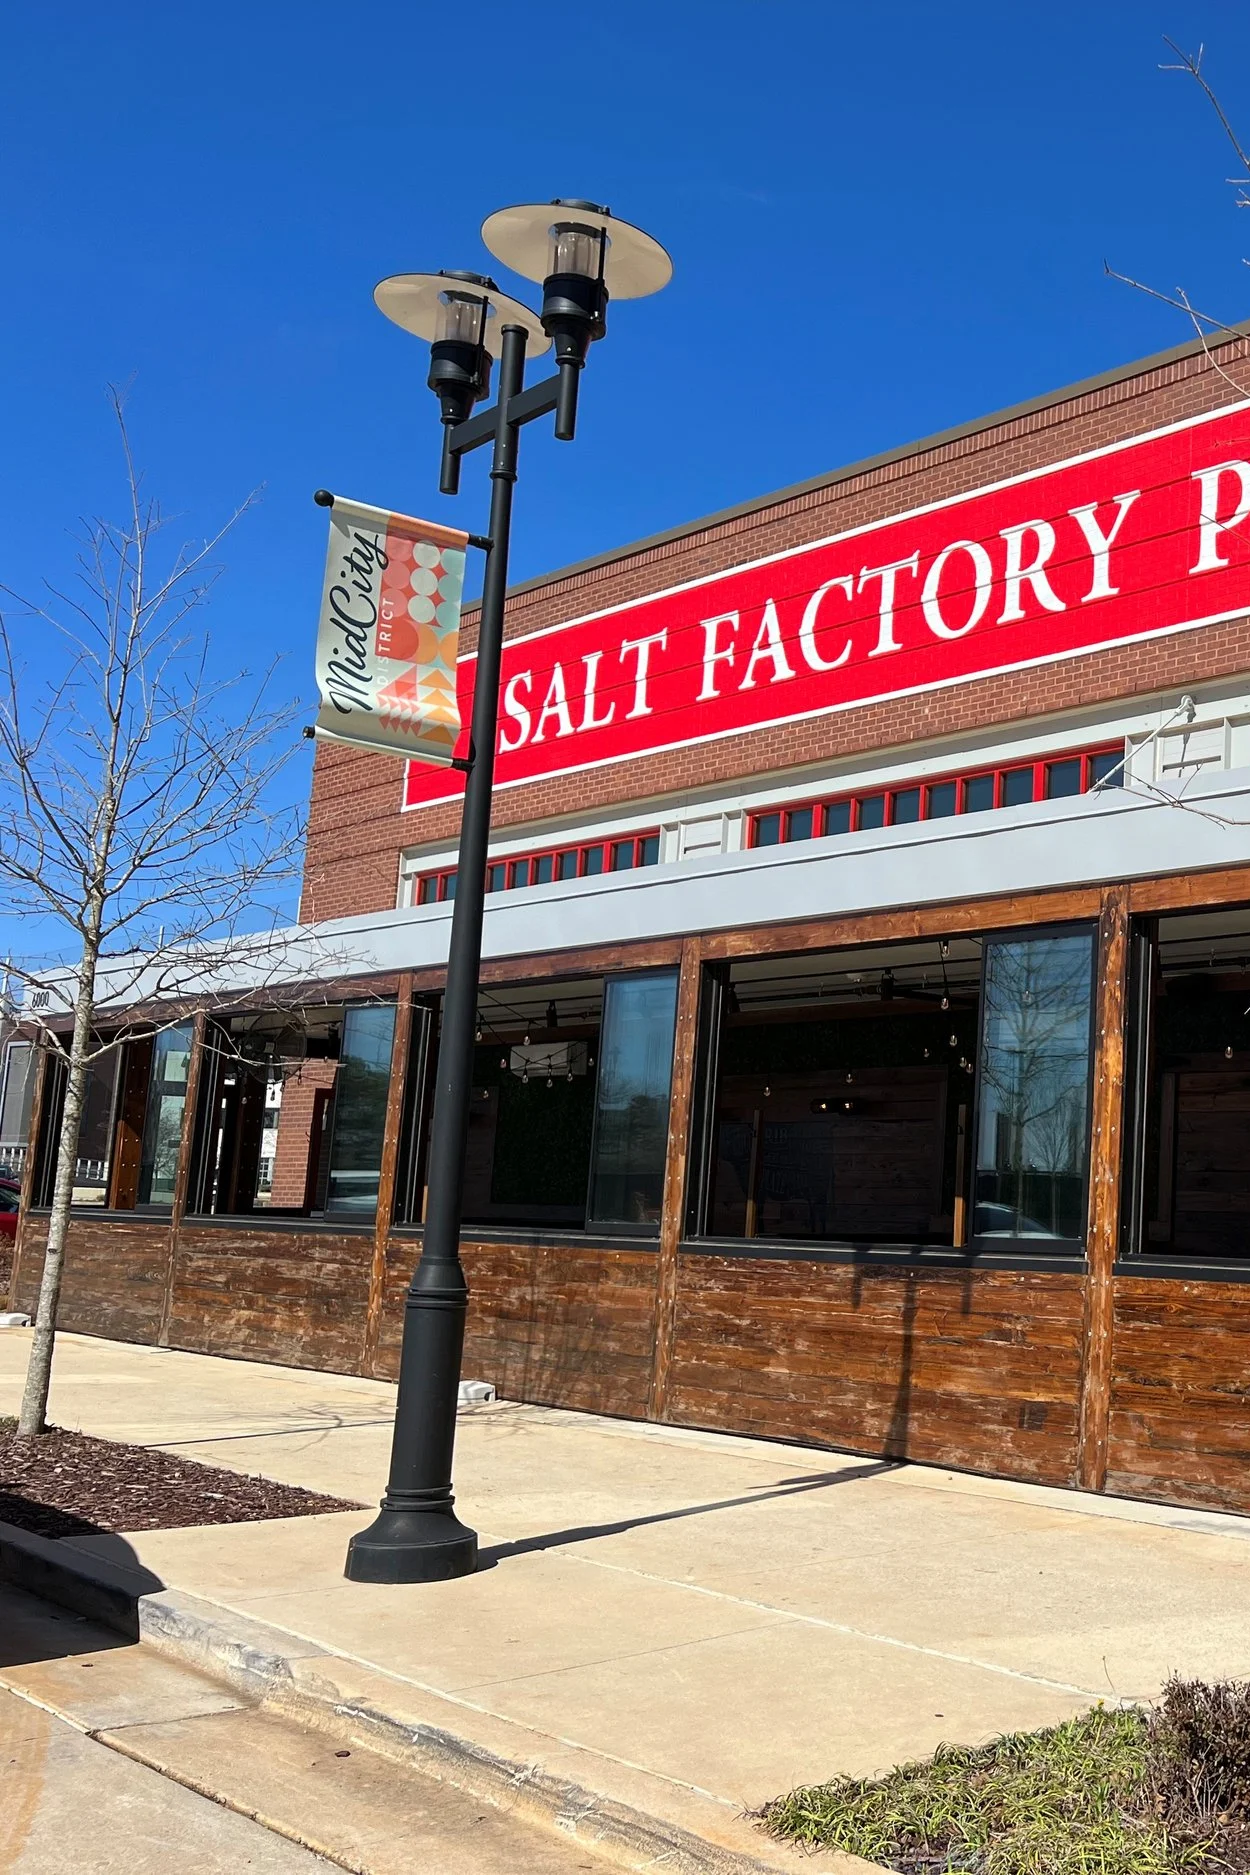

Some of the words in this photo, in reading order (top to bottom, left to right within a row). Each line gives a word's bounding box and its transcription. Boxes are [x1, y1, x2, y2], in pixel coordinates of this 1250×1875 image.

[325, 532, 389, 715] MidCity
[376, 597, 394, 686] DISTRICT
[498, 628, 668, 754] SALT
[695, 490, 1140, 701] FACTORY
